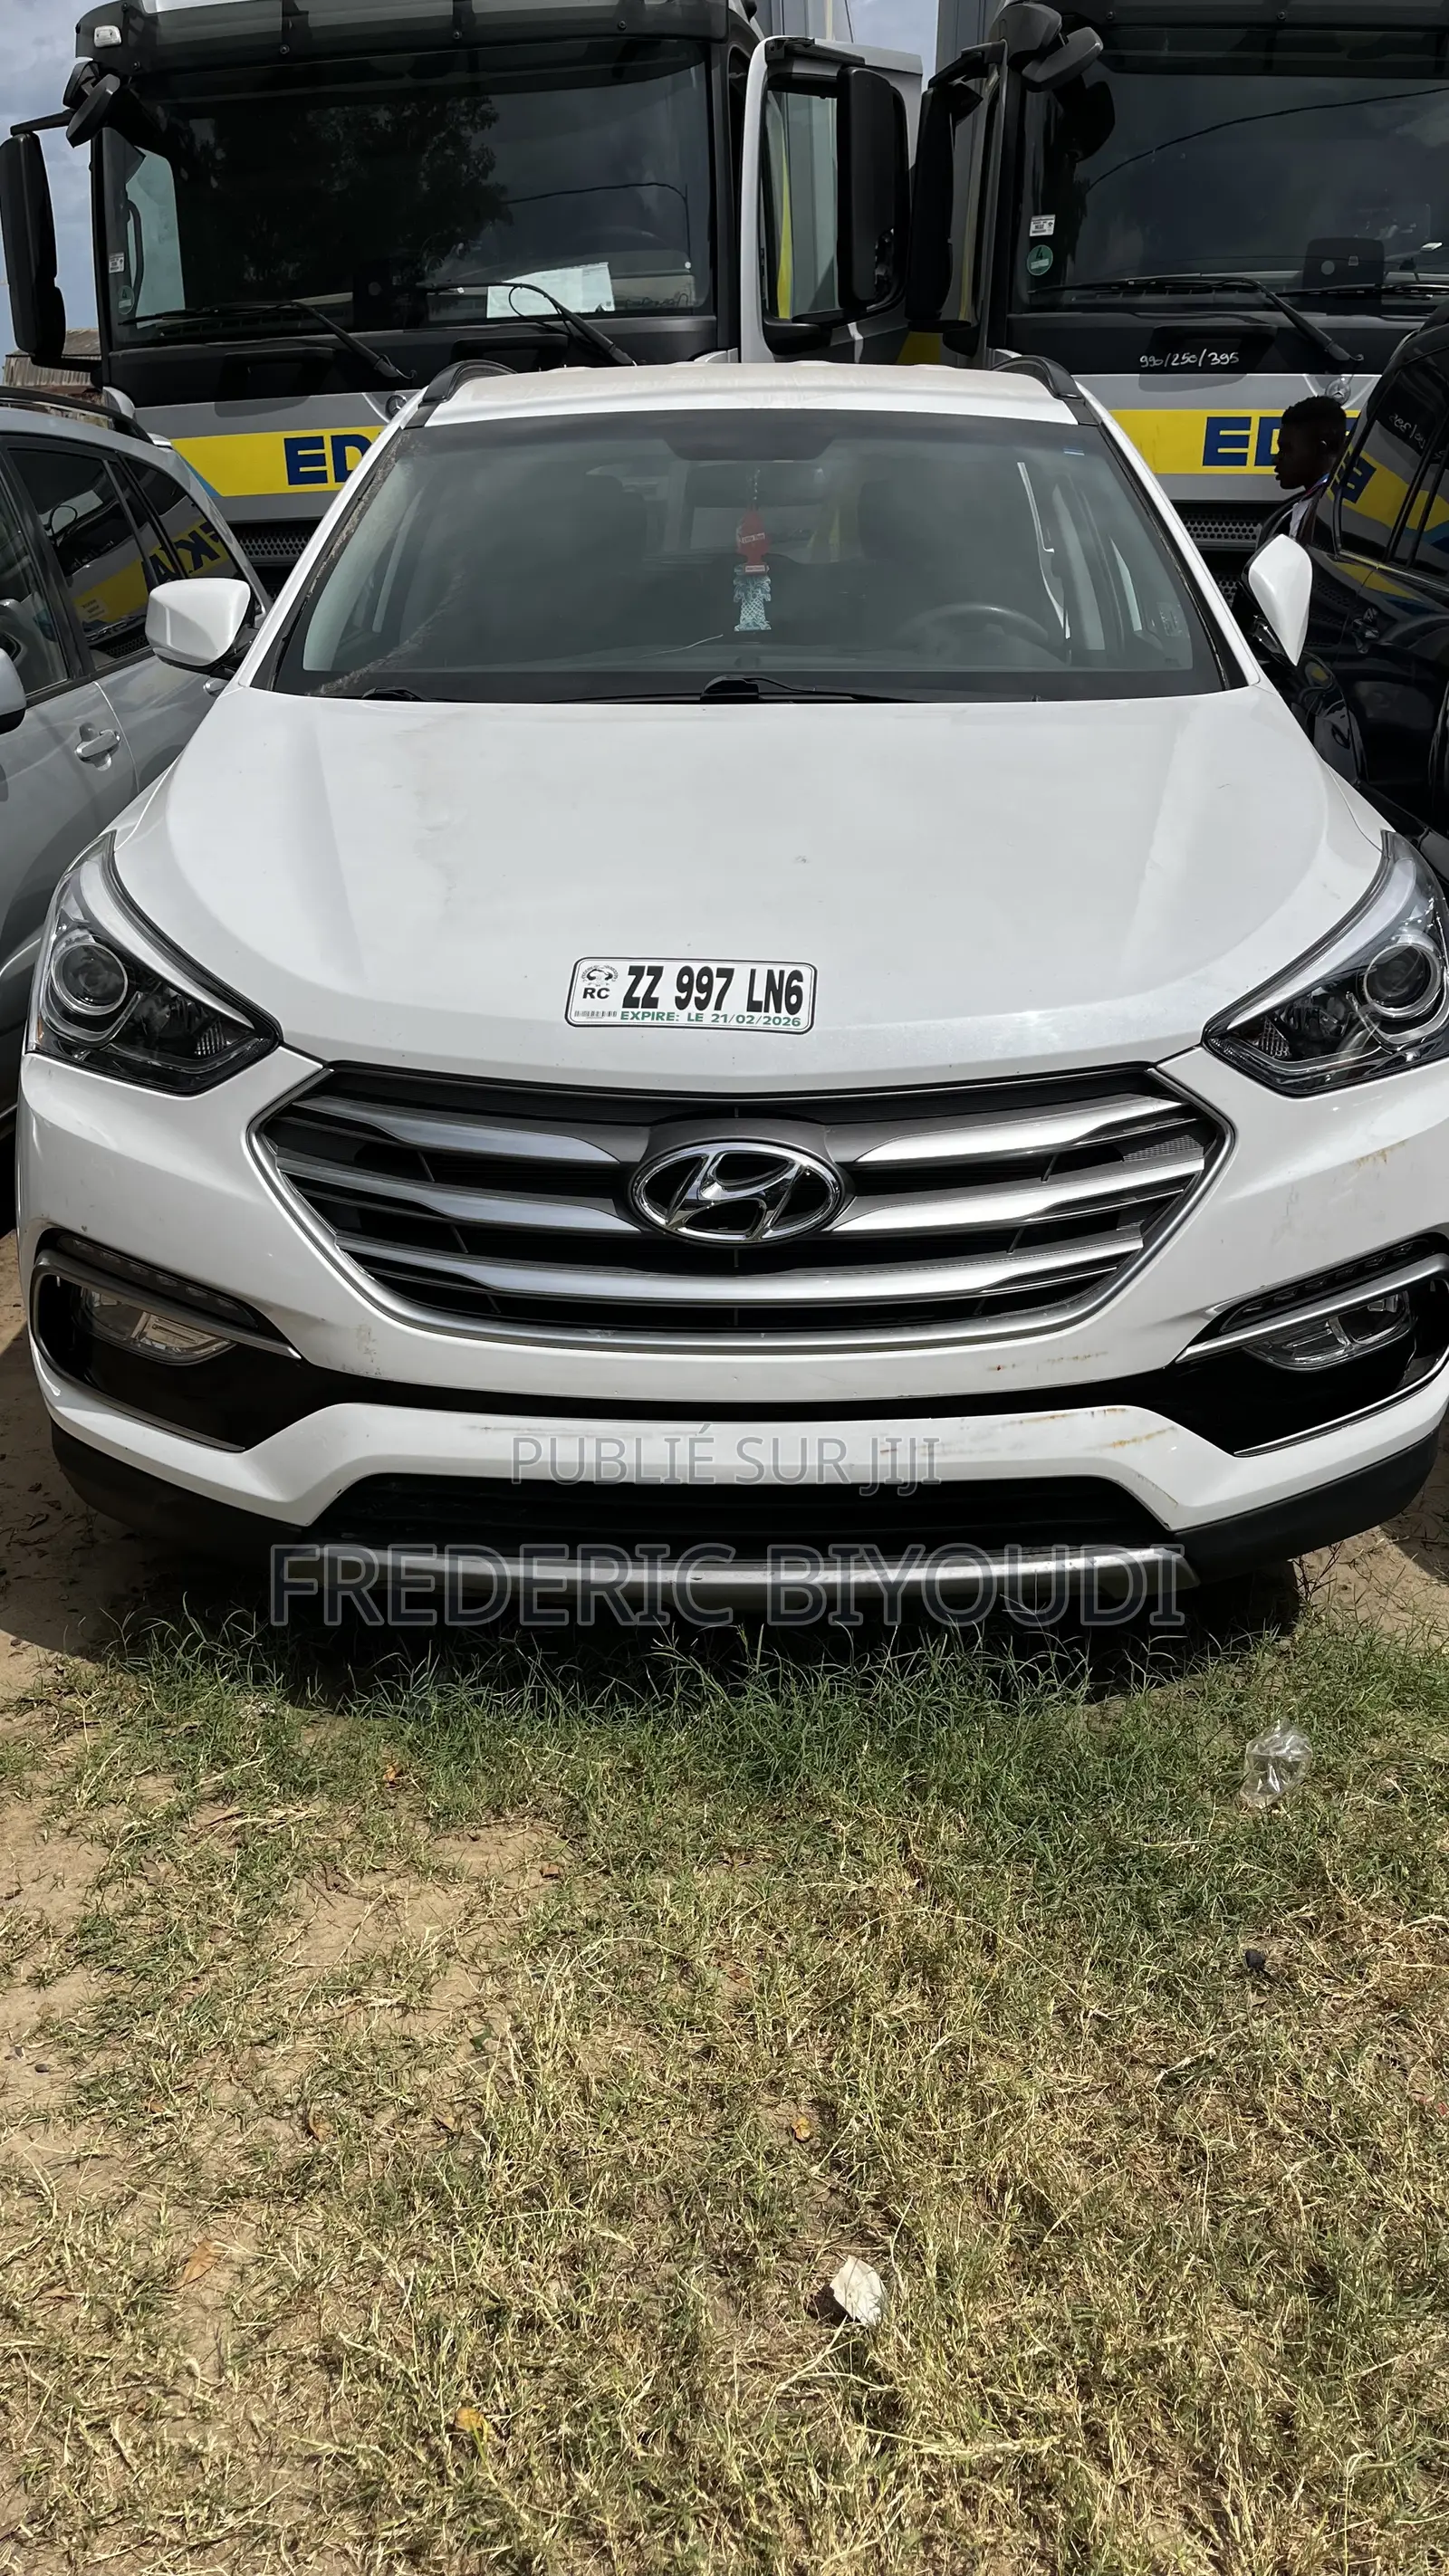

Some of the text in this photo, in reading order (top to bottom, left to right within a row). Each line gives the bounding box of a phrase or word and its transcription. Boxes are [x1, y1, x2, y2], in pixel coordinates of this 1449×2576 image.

[582, 987, 611, 1000] RC
[621, 964, 665, 1010] ZZ
[674, 965, 735, 1011] 997
[745, 968, 804, 1016] LN6
[619, 1010, 801, 1028] EXPIRE: LE 21/02/2026
